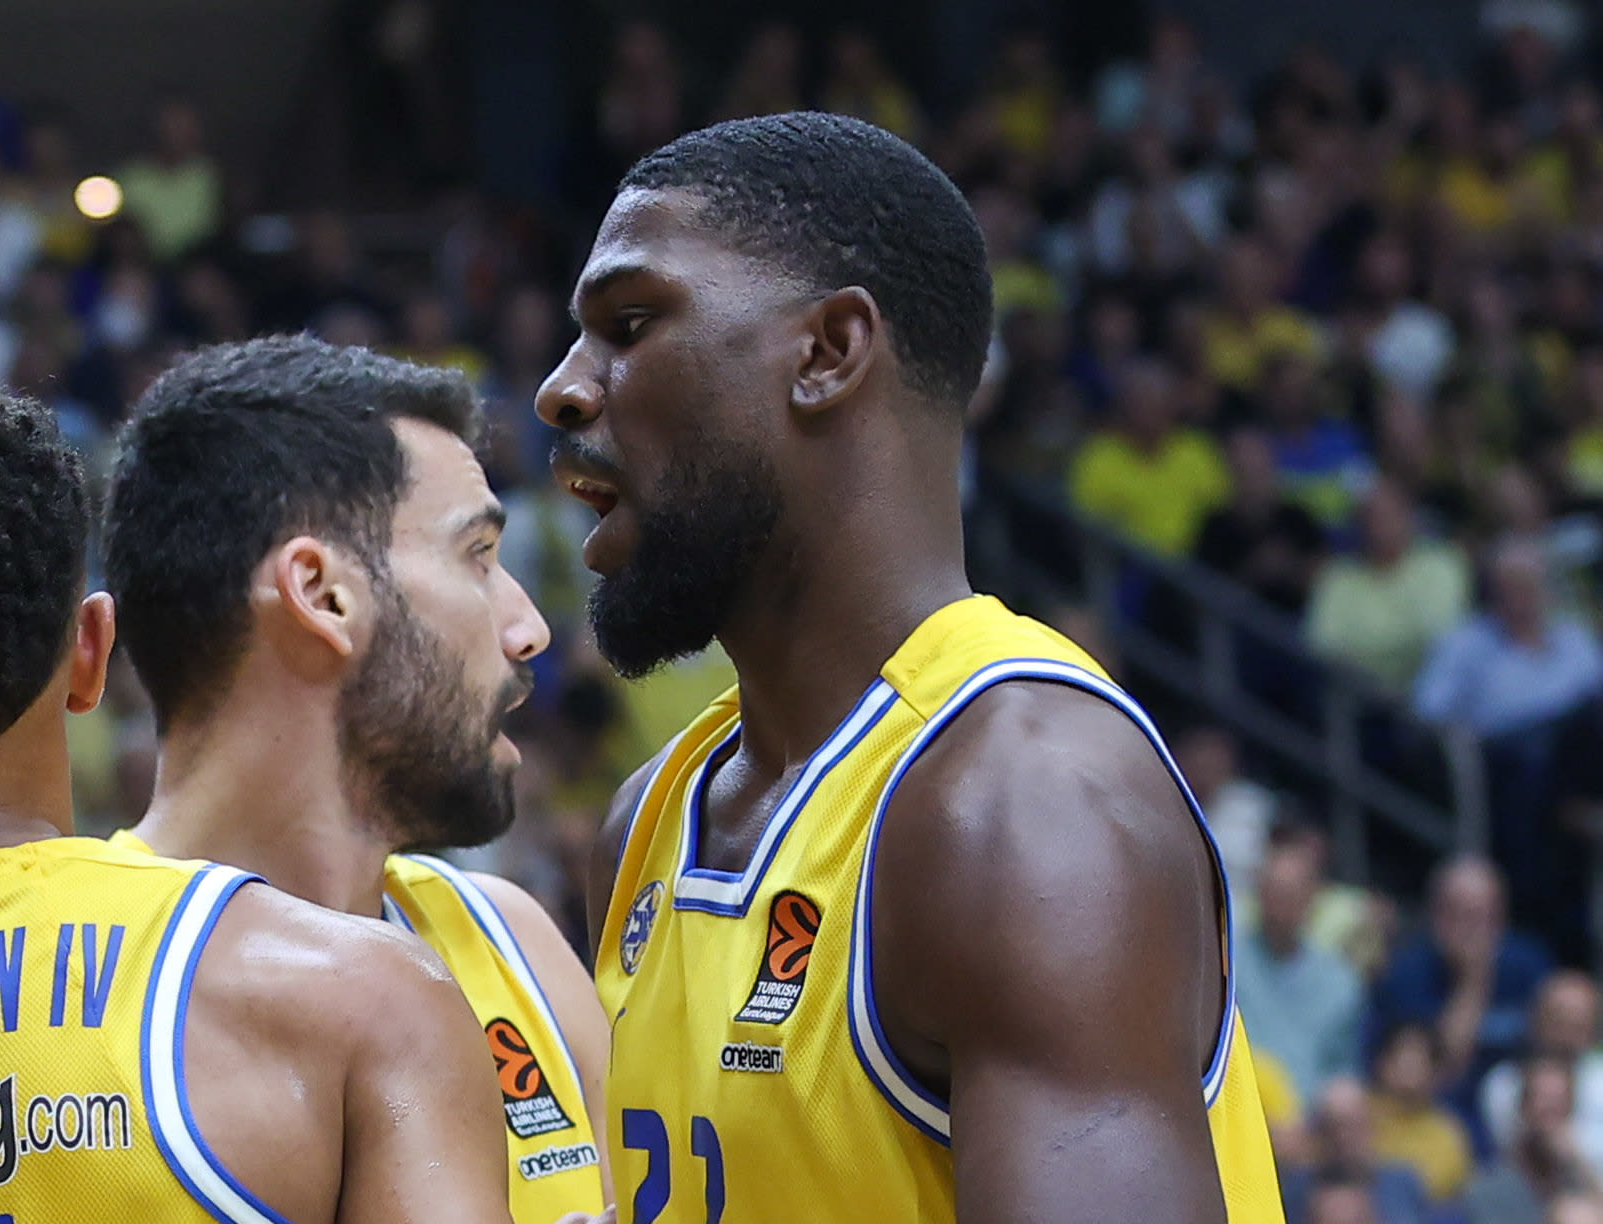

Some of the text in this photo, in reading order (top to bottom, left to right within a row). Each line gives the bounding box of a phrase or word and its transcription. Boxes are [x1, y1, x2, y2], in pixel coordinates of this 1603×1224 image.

[49, 923, 125, 1028] IV
[757, 981, 801, 998] TURKISH
[747, 994, 794, 1011] AIRLINES
